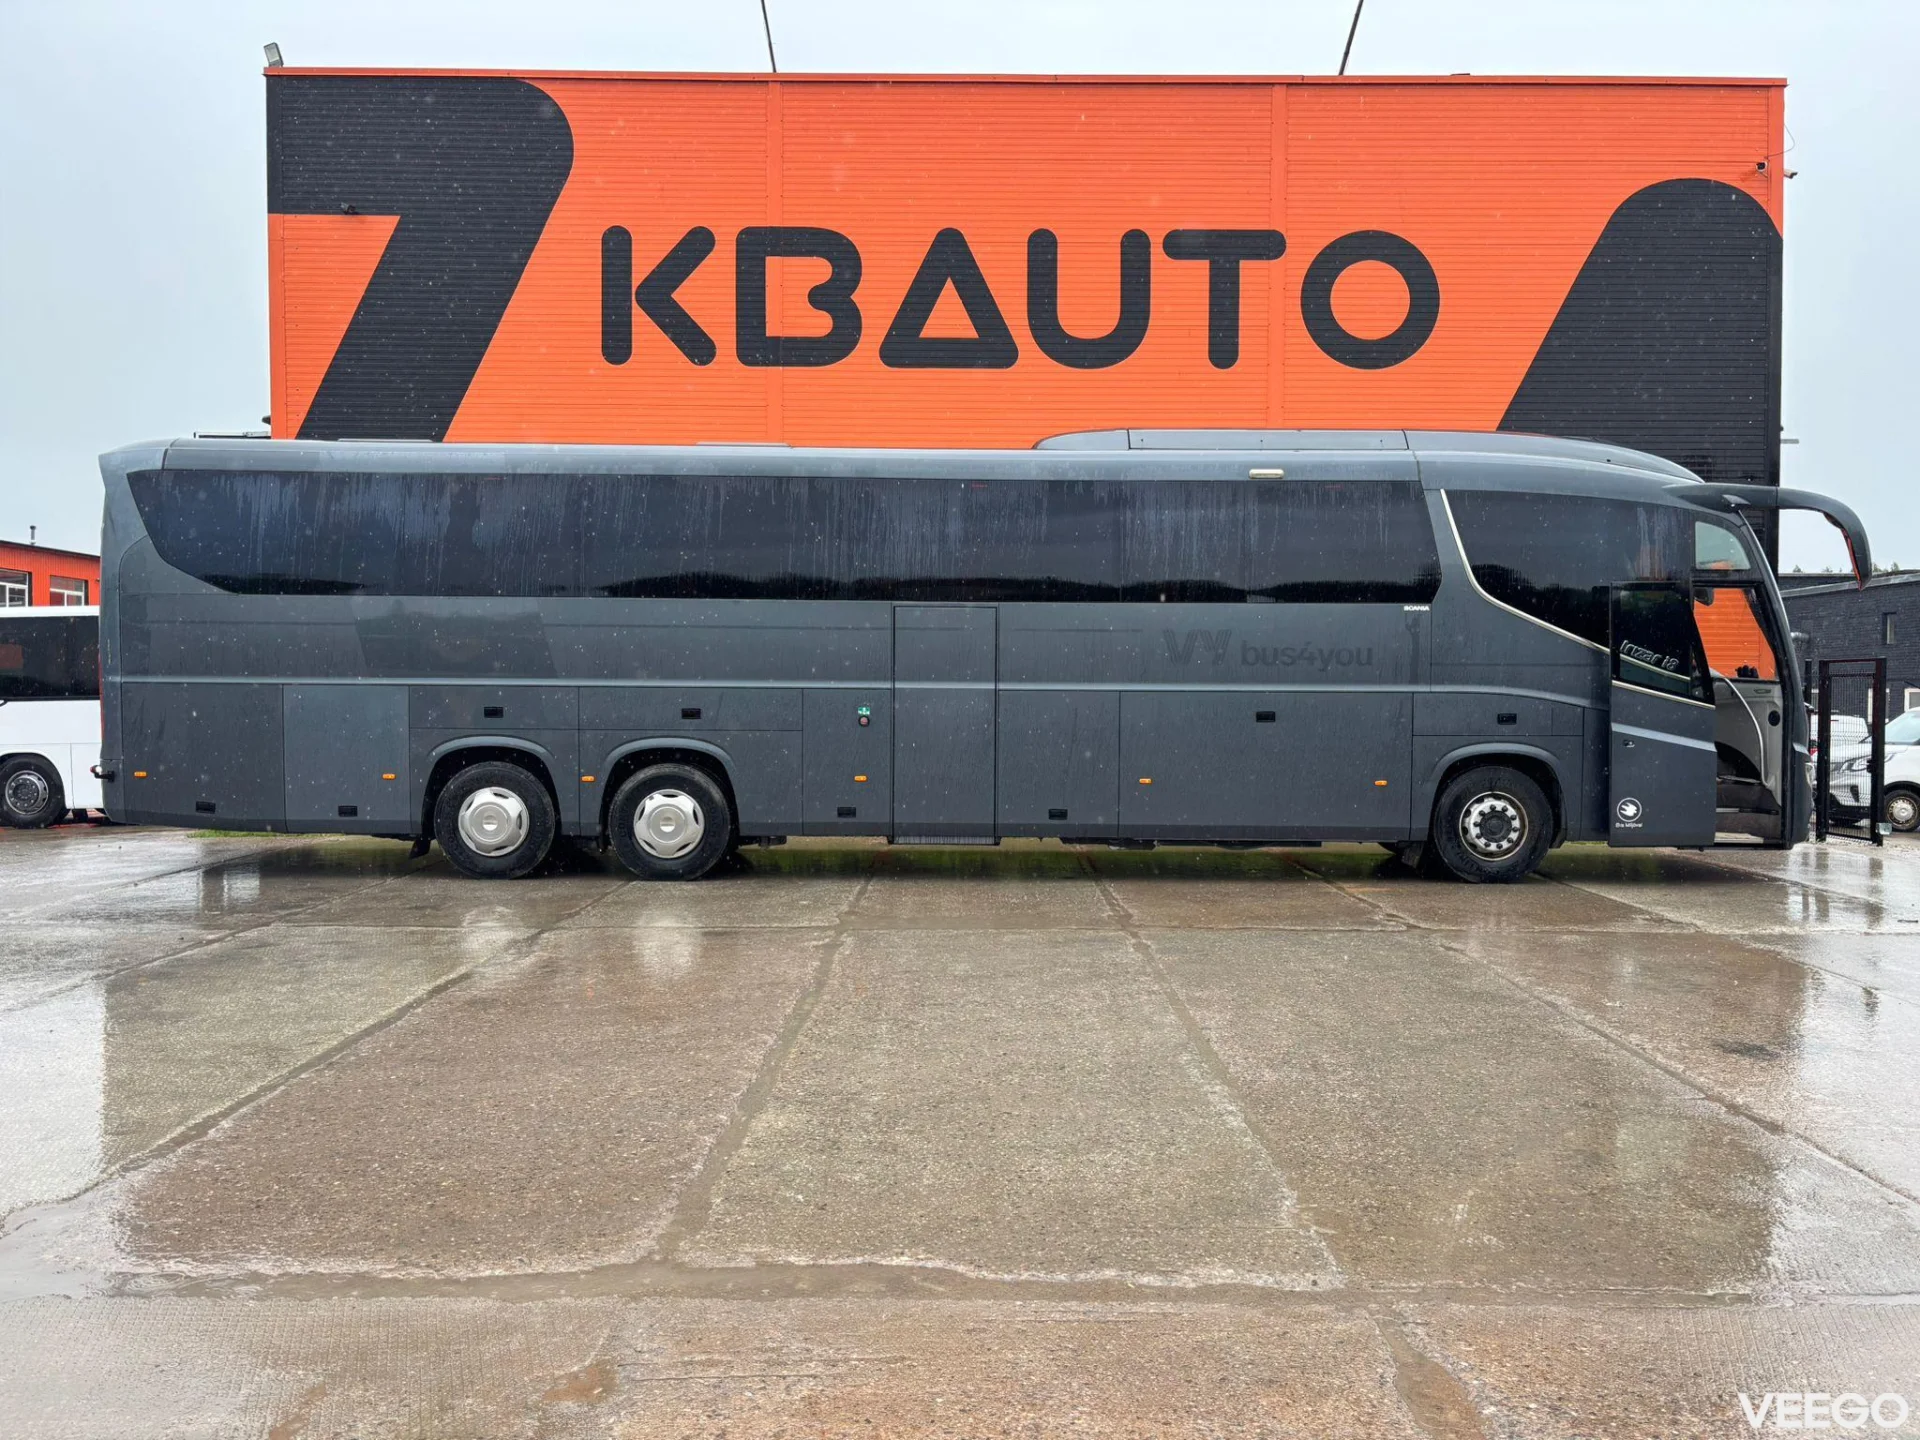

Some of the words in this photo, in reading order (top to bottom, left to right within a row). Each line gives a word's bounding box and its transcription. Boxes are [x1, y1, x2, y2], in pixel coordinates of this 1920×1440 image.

[600, 224, 1441, 370] KBAUTO
[1241, 640, 1373, 672] bus4you
[1619, 640, 1662, 665] Irizar
[1661, 655, 1680, 671] i8
